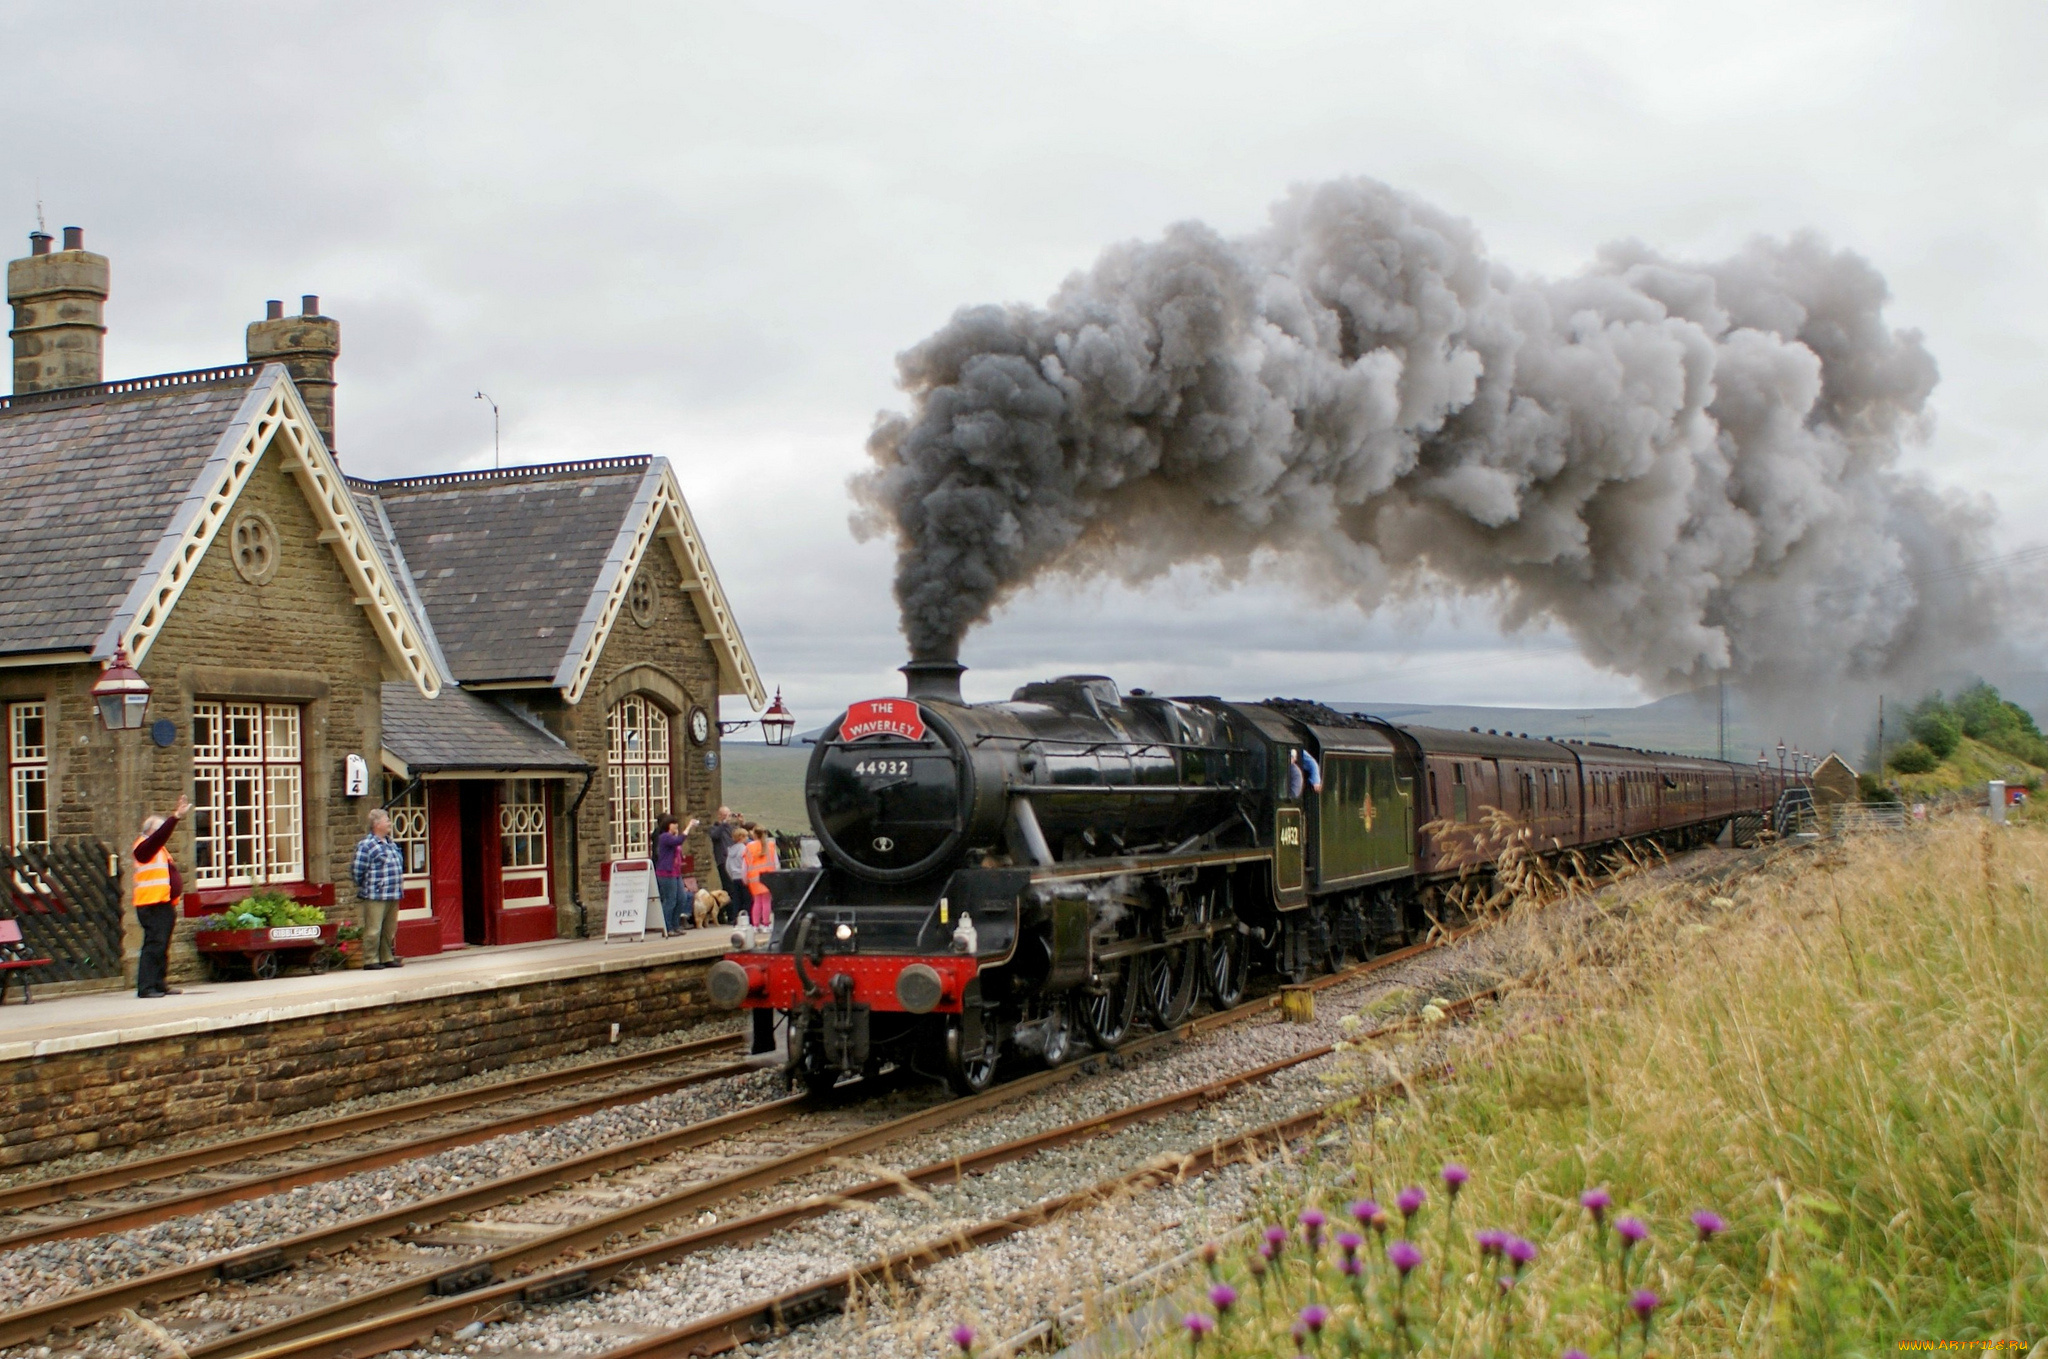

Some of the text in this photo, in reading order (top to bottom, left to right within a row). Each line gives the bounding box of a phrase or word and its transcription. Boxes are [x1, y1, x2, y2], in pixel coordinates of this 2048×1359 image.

[871, 703, 893, 713] THE
[849, 720, 915, 736] WAVERLEY
[855, 761, 908, 775] 44932
[615, 909, 639, 918] OPEN
[273, 928, 318, 937] RIBBLEHEAD
